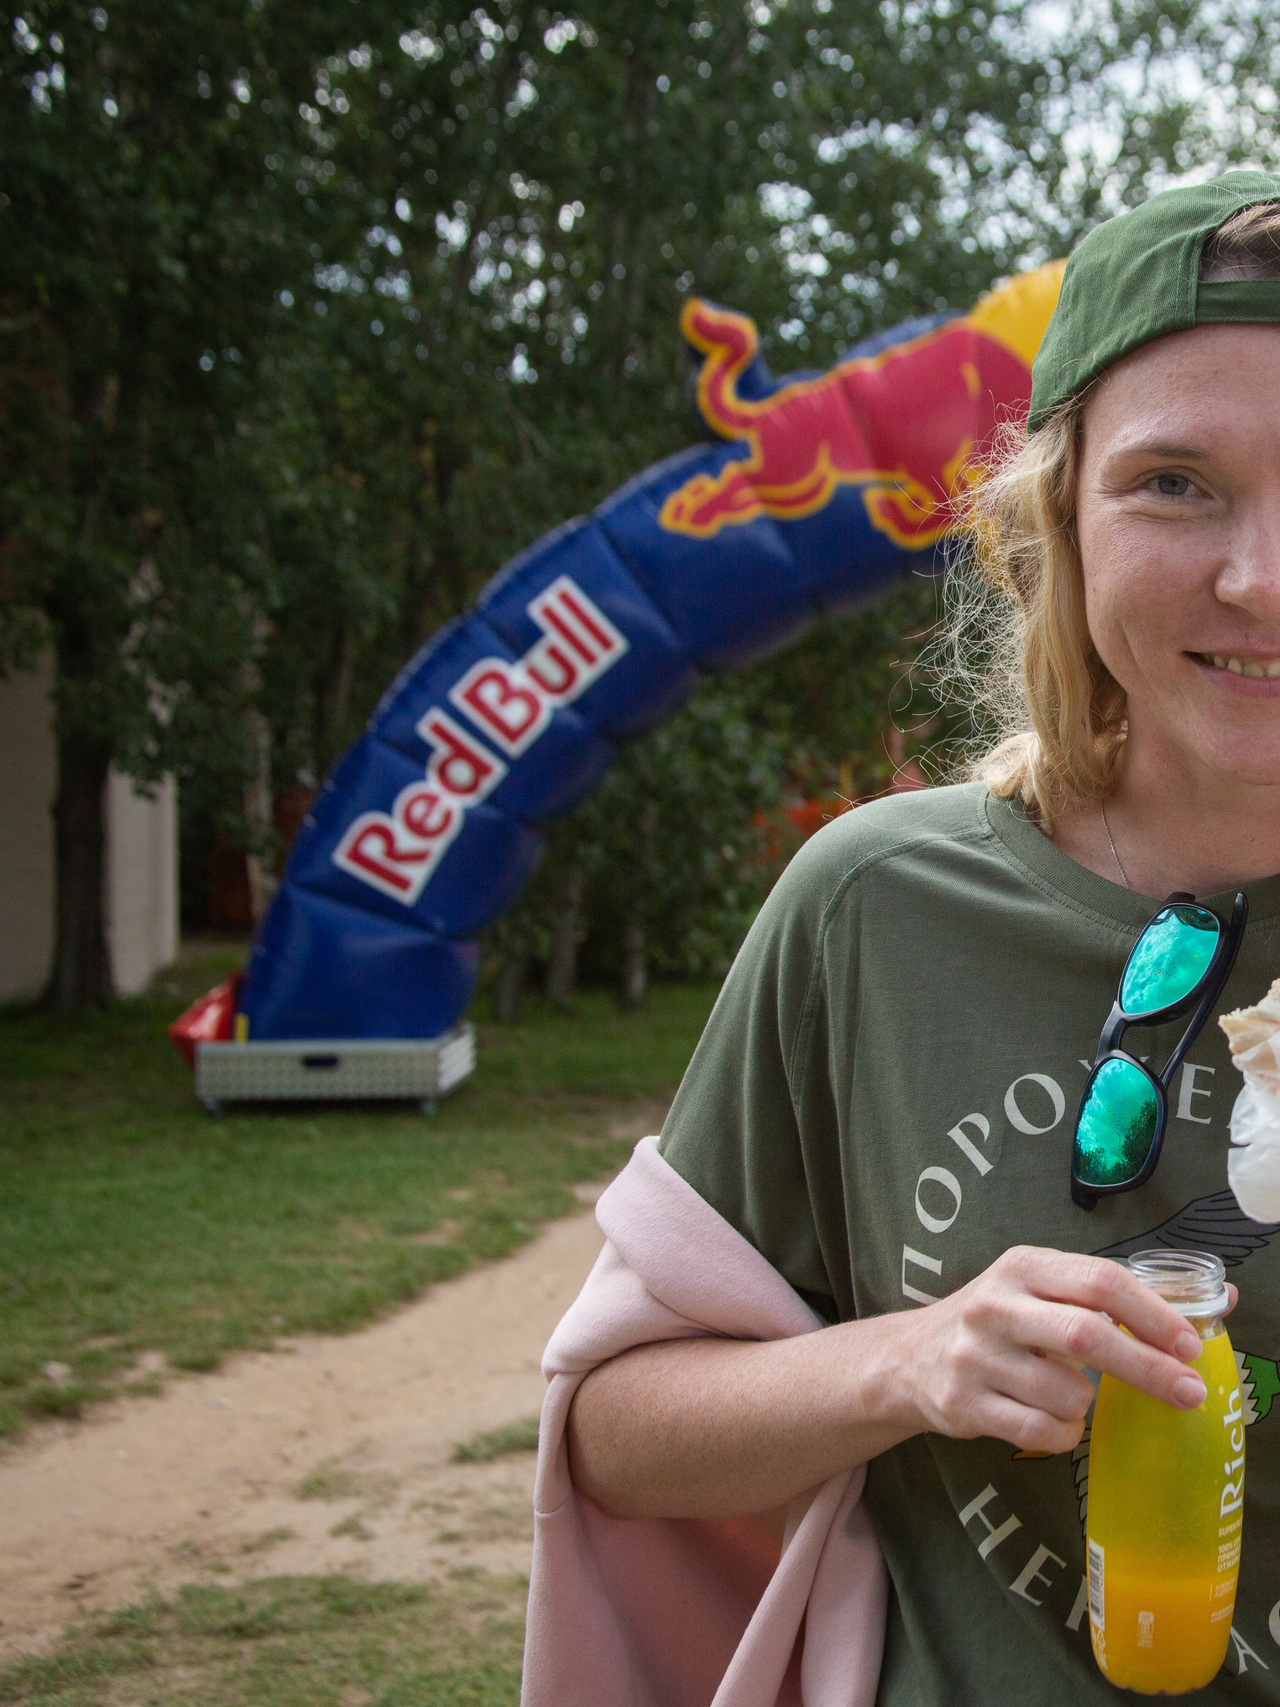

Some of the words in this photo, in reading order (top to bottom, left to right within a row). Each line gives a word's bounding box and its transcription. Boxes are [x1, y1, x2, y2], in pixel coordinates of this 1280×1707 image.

[342, 714, 499, 896] Red
[457, 584, 620, 748] Bull
[1219, 1386, 1244, 1520] Rich
